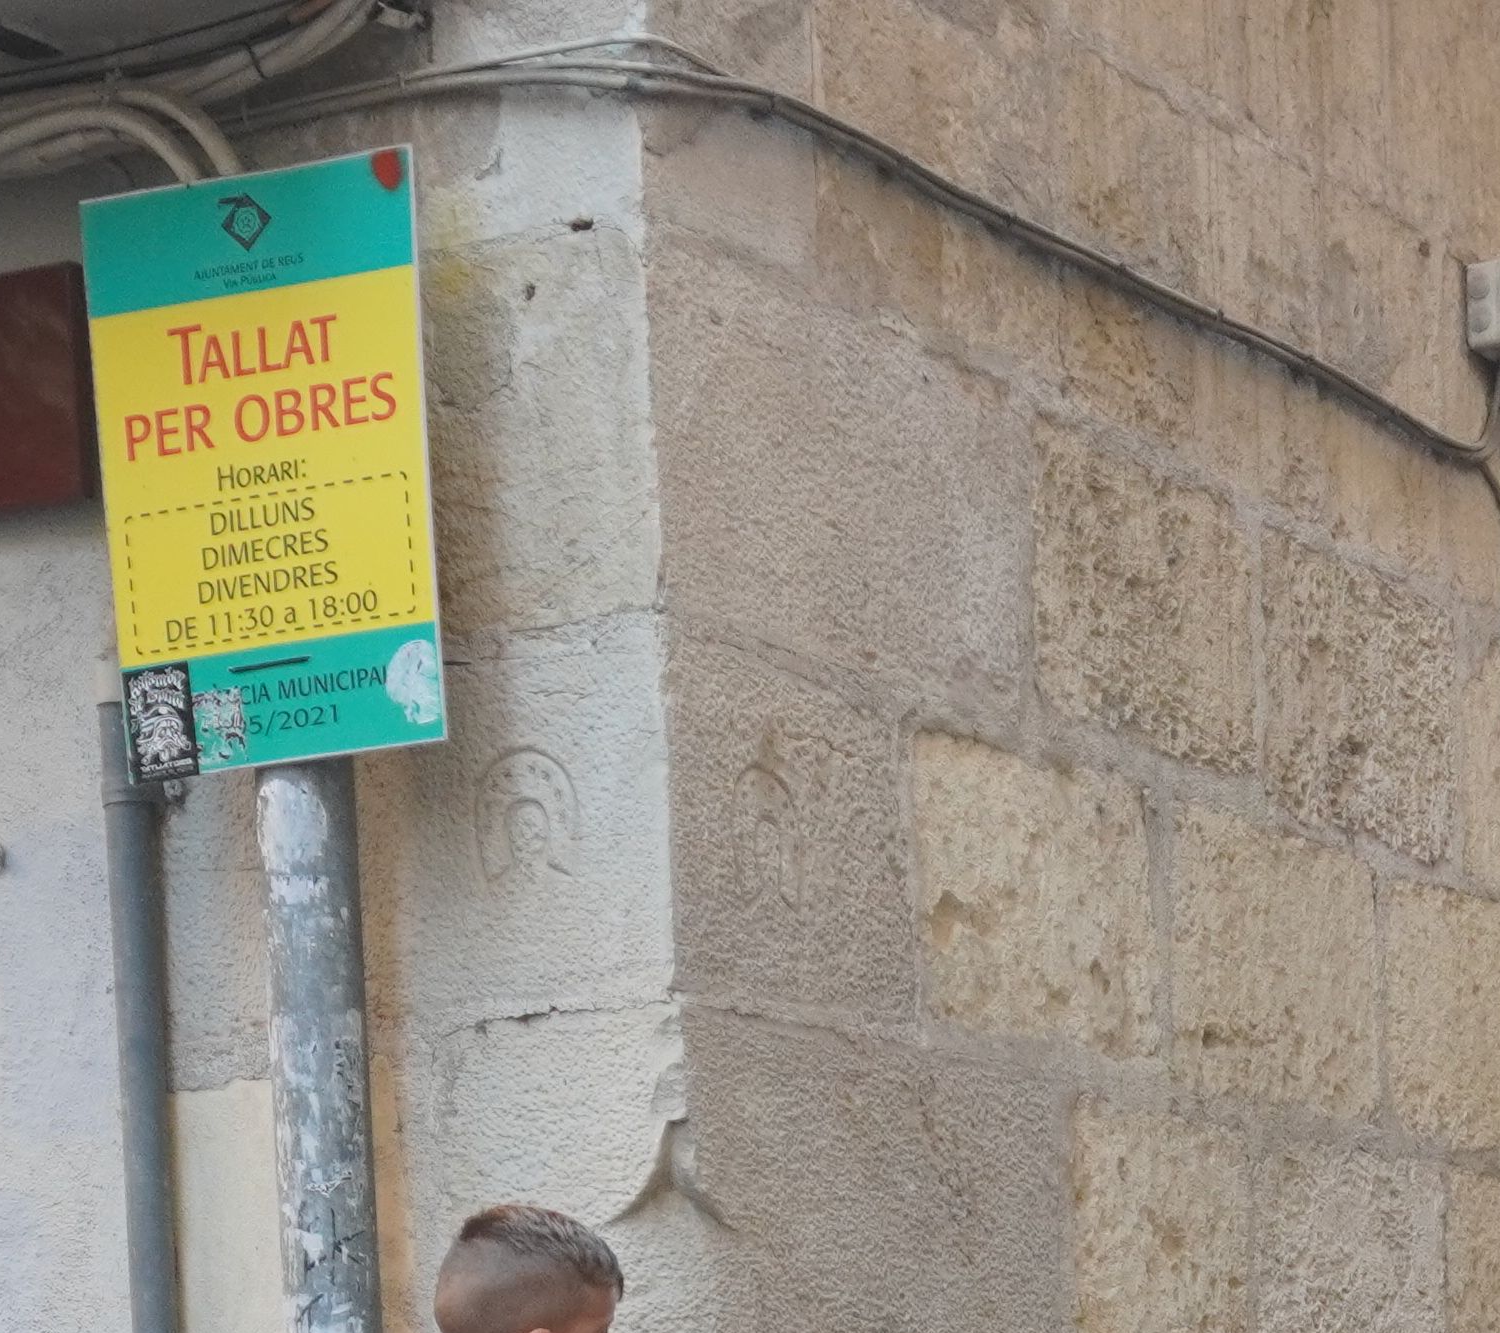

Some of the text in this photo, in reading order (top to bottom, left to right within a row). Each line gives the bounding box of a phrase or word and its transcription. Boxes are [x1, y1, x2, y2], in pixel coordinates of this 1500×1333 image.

[194, 253, 304, 281] AJUNTAMENT DE REUS
[167, 314, 337, 386] TALLAT
[124, 371, 397, 462] PER OBRES
[216, 458, 307, 492] HORARI:
[209, 497, 316, 536] DILLUNS
[201, 528, 329, 571] DIMECRES
[197, 561, 339, 605] DIVENDRES
[165, 589, 379, 643] DE 11:30 a 18:00
[241, 703, 340, 736] 5/2021
